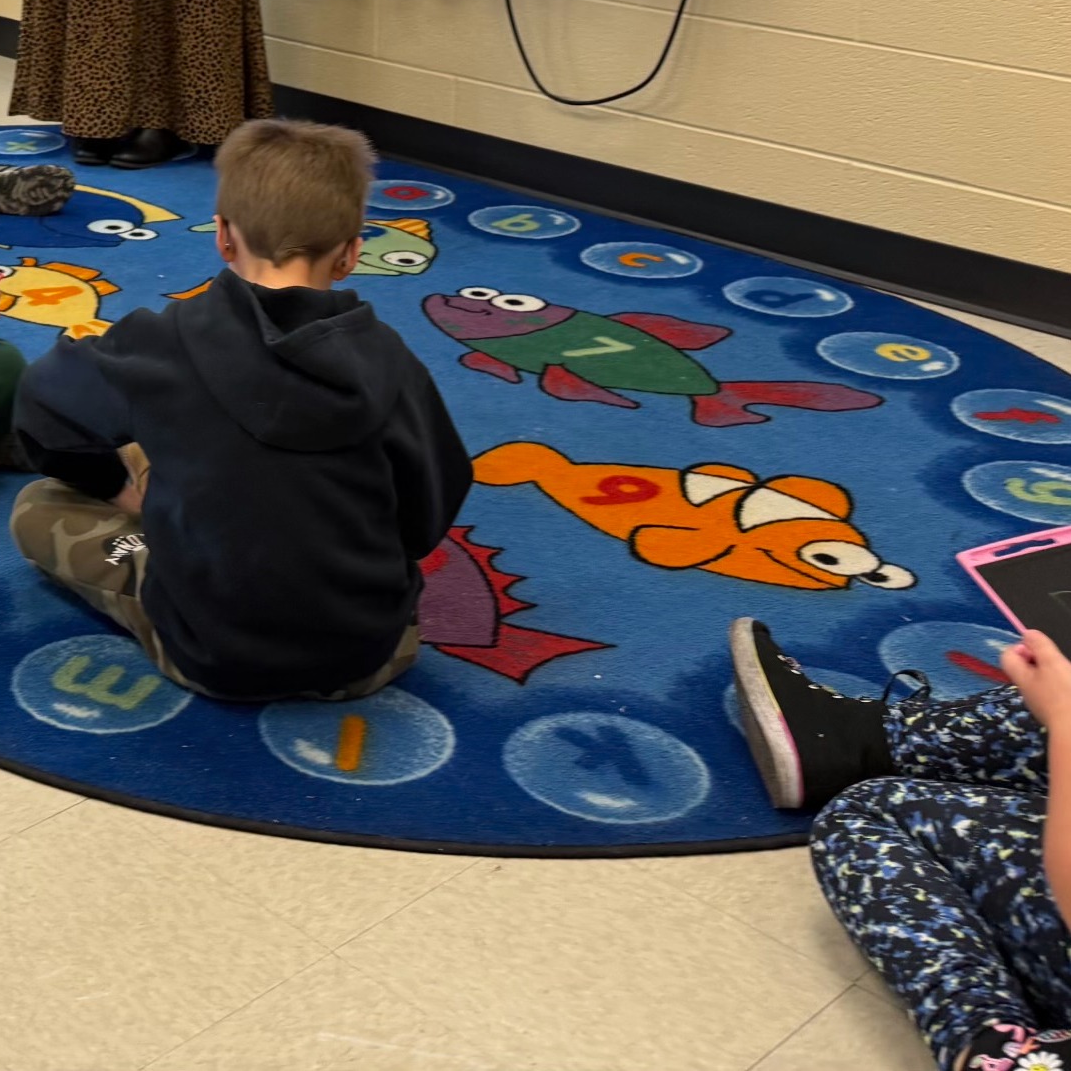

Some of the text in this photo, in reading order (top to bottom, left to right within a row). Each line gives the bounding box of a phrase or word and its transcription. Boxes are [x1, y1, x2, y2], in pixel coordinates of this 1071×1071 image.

[491, 213, 540, 233] b
[618, 251, 665, 267] c
[21, 285, 84, 307] 4
[561, 336, 637, 357] 7
[875, 343, 932, 362] e
